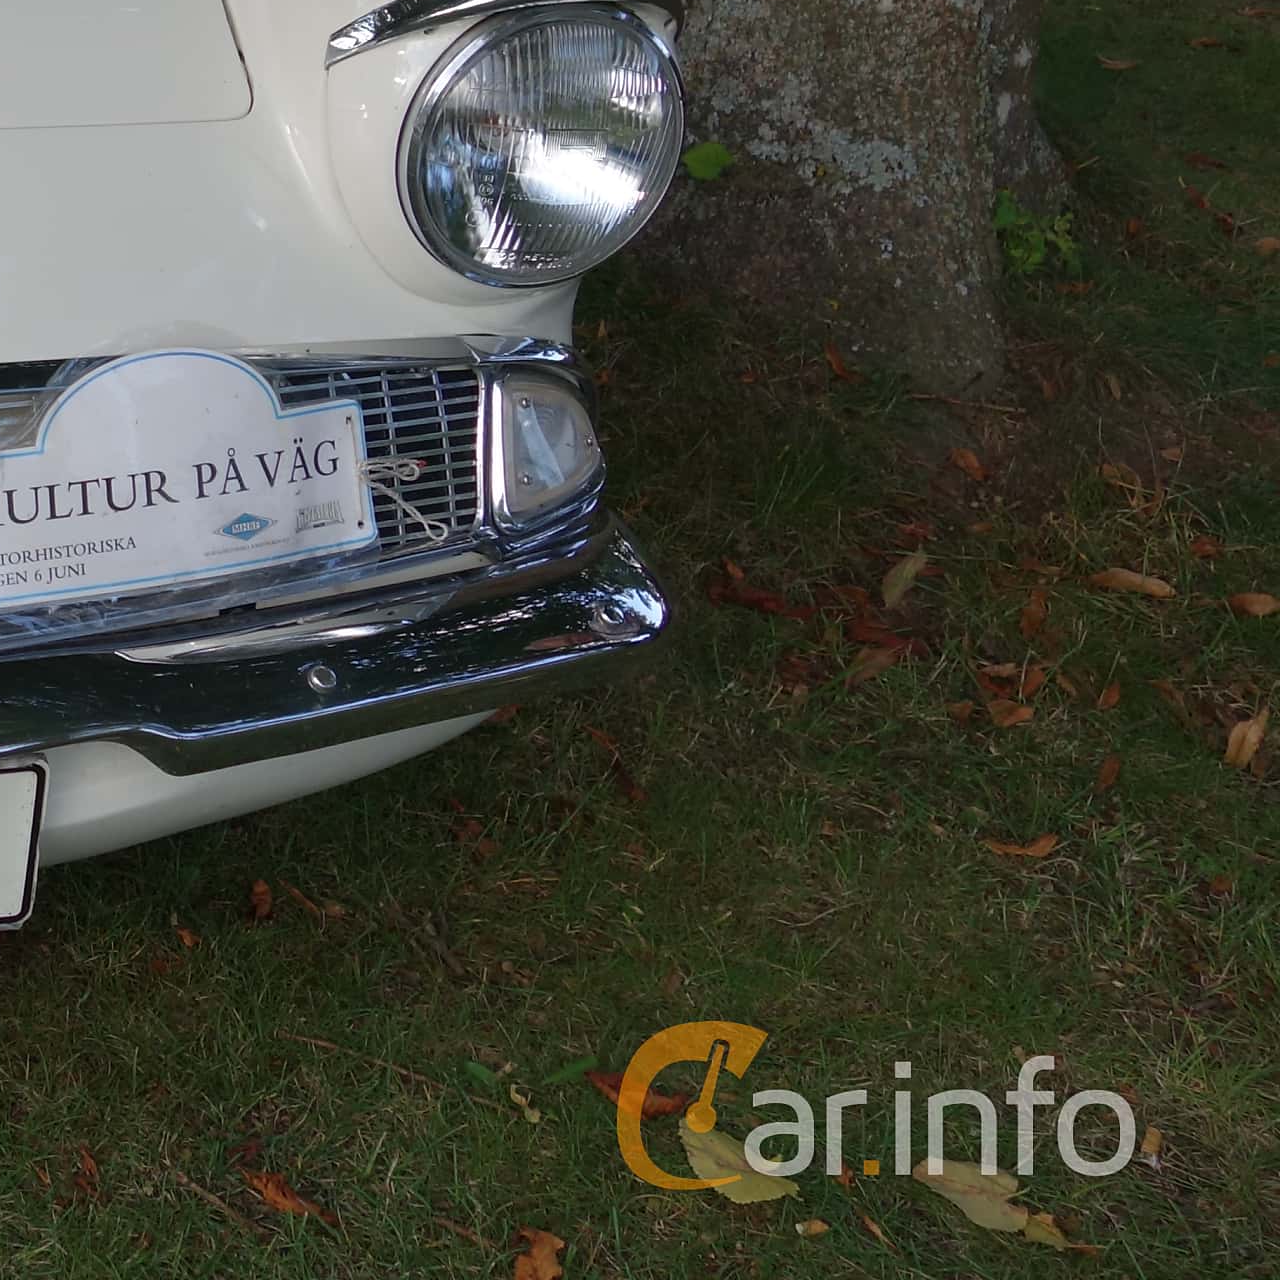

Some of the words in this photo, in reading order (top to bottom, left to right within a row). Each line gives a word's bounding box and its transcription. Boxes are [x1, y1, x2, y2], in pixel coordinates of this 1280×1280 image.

[192, 447, 249, 499] PÅ
[255, 437, 339, 488] VÄG
[34, 569, 42, 582] 6
[45, 563, 86, 585] JUNI
